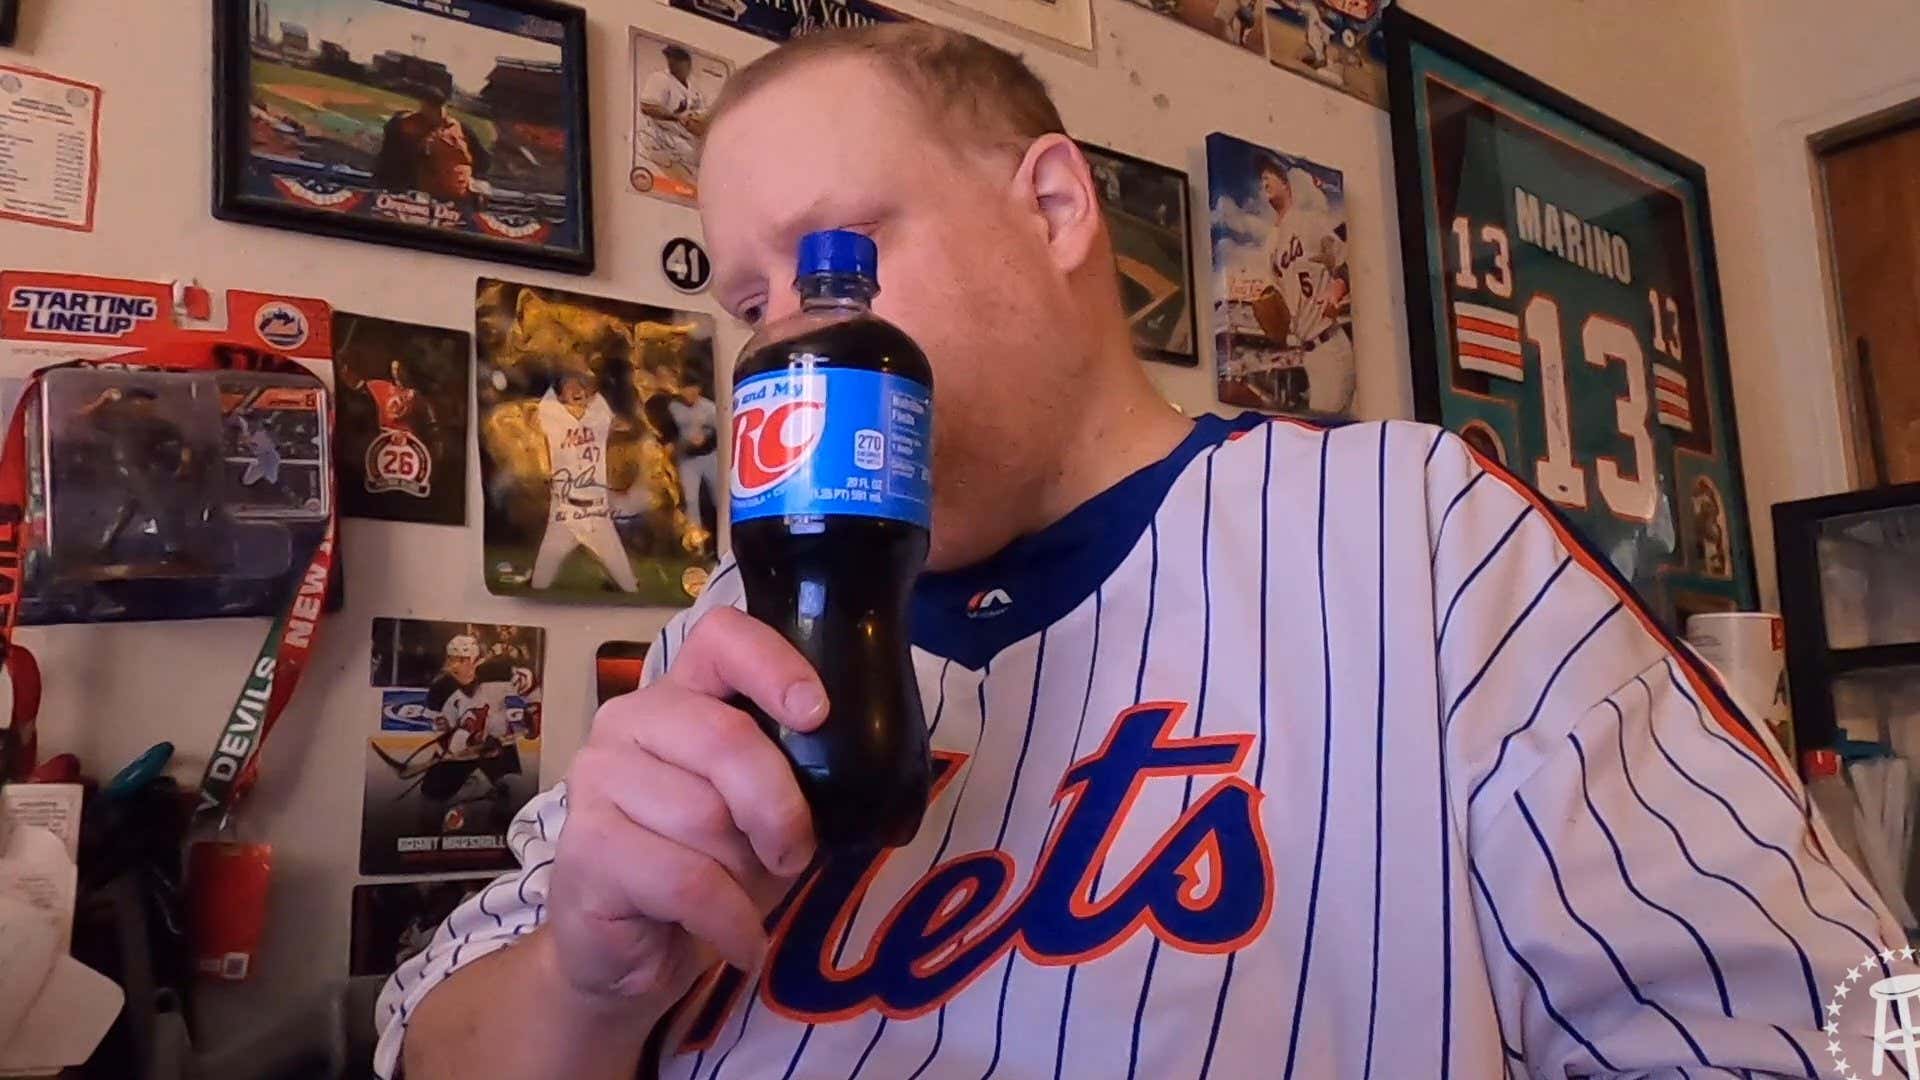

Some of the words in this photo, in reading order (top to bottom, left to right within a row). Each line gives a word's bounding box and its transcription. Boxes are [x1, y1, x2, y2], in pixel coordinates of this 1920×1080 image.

[1515, 185, 1632, 285] MARINO
[666, 244, 701, 283] 41
[1452, 216, 1513, 298] 13
[1298, 272, 1313, 298] 5
[13, 288, 155, 318] STARTING
[30, 311, 132, 334] LINEUP
[1648, 287, 1682, 361] 13
[741, 385, 767, 404] and
[772, 382, 804, 398] My
[1525, 296, 1657, 522] 13
[560, 425, 596, 449] Mets
[732, 401, 821, 489] RC
[857, 434, 881, 450] 270
[383, 450, 414, 475] 26
[582, 447, 600, 462] 47
[285, 561, 328, 650] NEW
[209, 655, 278, 783] DEVILS
